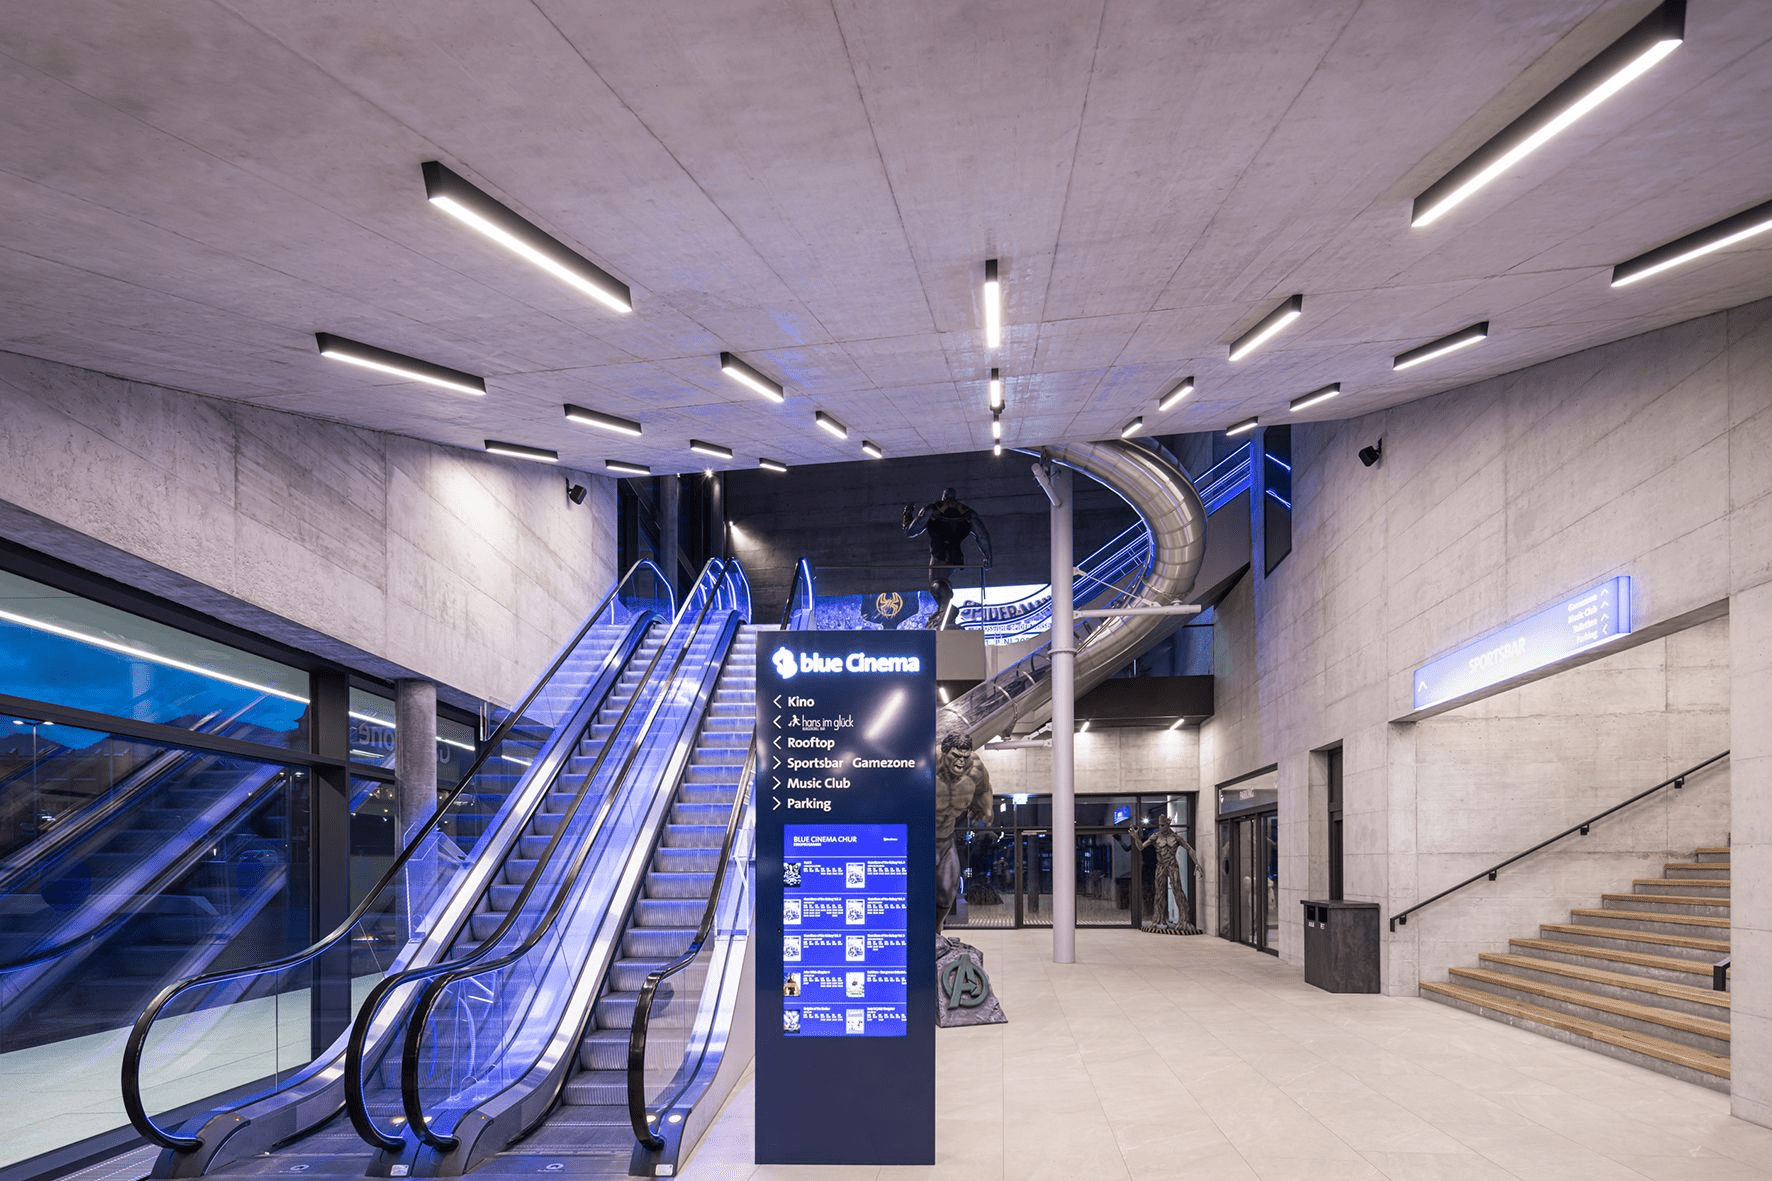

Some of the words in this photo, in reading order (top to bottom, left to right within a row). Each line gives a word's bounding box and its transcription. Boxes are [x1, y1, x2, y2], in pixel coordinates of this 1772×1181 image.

[800, 652, 843, 673] blue
[846, 652, 920, 673] Cinema
[1469, 638, 1526, 674] SPORTSBAR
[787, 695, 815, 708] Kino
[801, 714, 821, 728] hans
[822, 717, 833, 727] im
[833, 714, 854, 731] glück
[787, 737, 835, 751] Rooftop
[787, 757, 844, 771] Sportsbar
[852, 757, 916, 769] Gamezone
[787, 777, 822, 789] Music
[824, 777, 851, 789] Club
[787, 797, 832, 812] Parking
